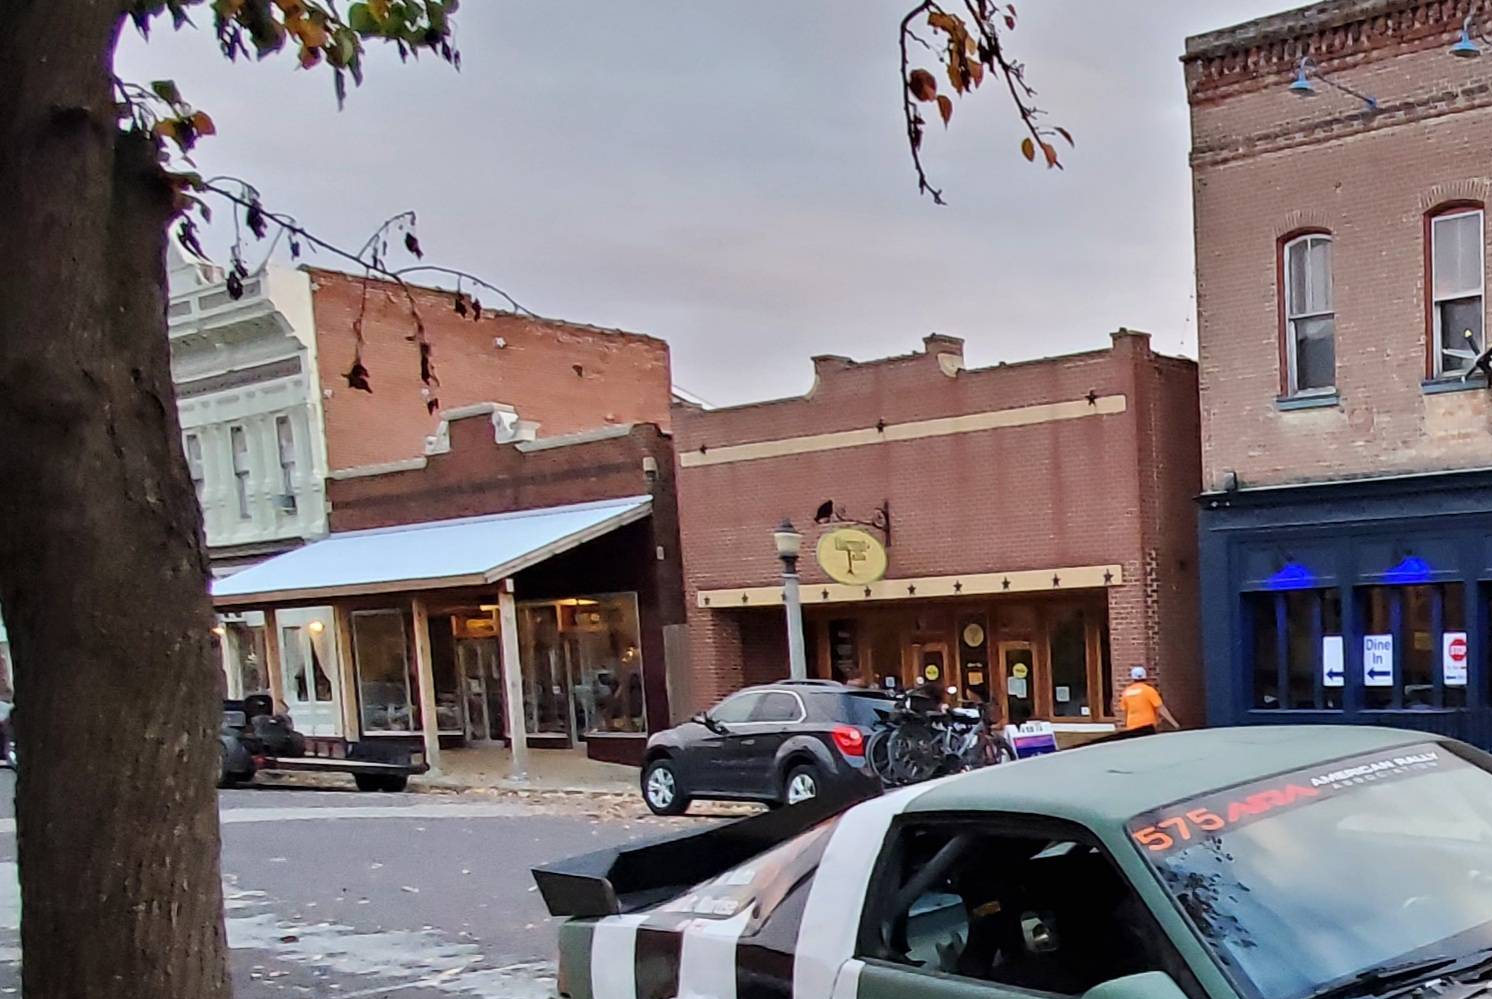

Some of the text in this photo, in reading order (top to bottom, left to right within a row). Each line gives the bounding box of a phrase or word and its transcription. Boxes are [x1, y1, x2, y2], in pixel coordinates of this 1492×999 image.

[1366, 638, 1391, 650] Dine
[1373, 653, 1383, 665] In
[1132, 807, 1225, 851] 575
[1310, 759, 1396, 787] AMERICAN
[1393, 751, 1438, 766] RALLY
